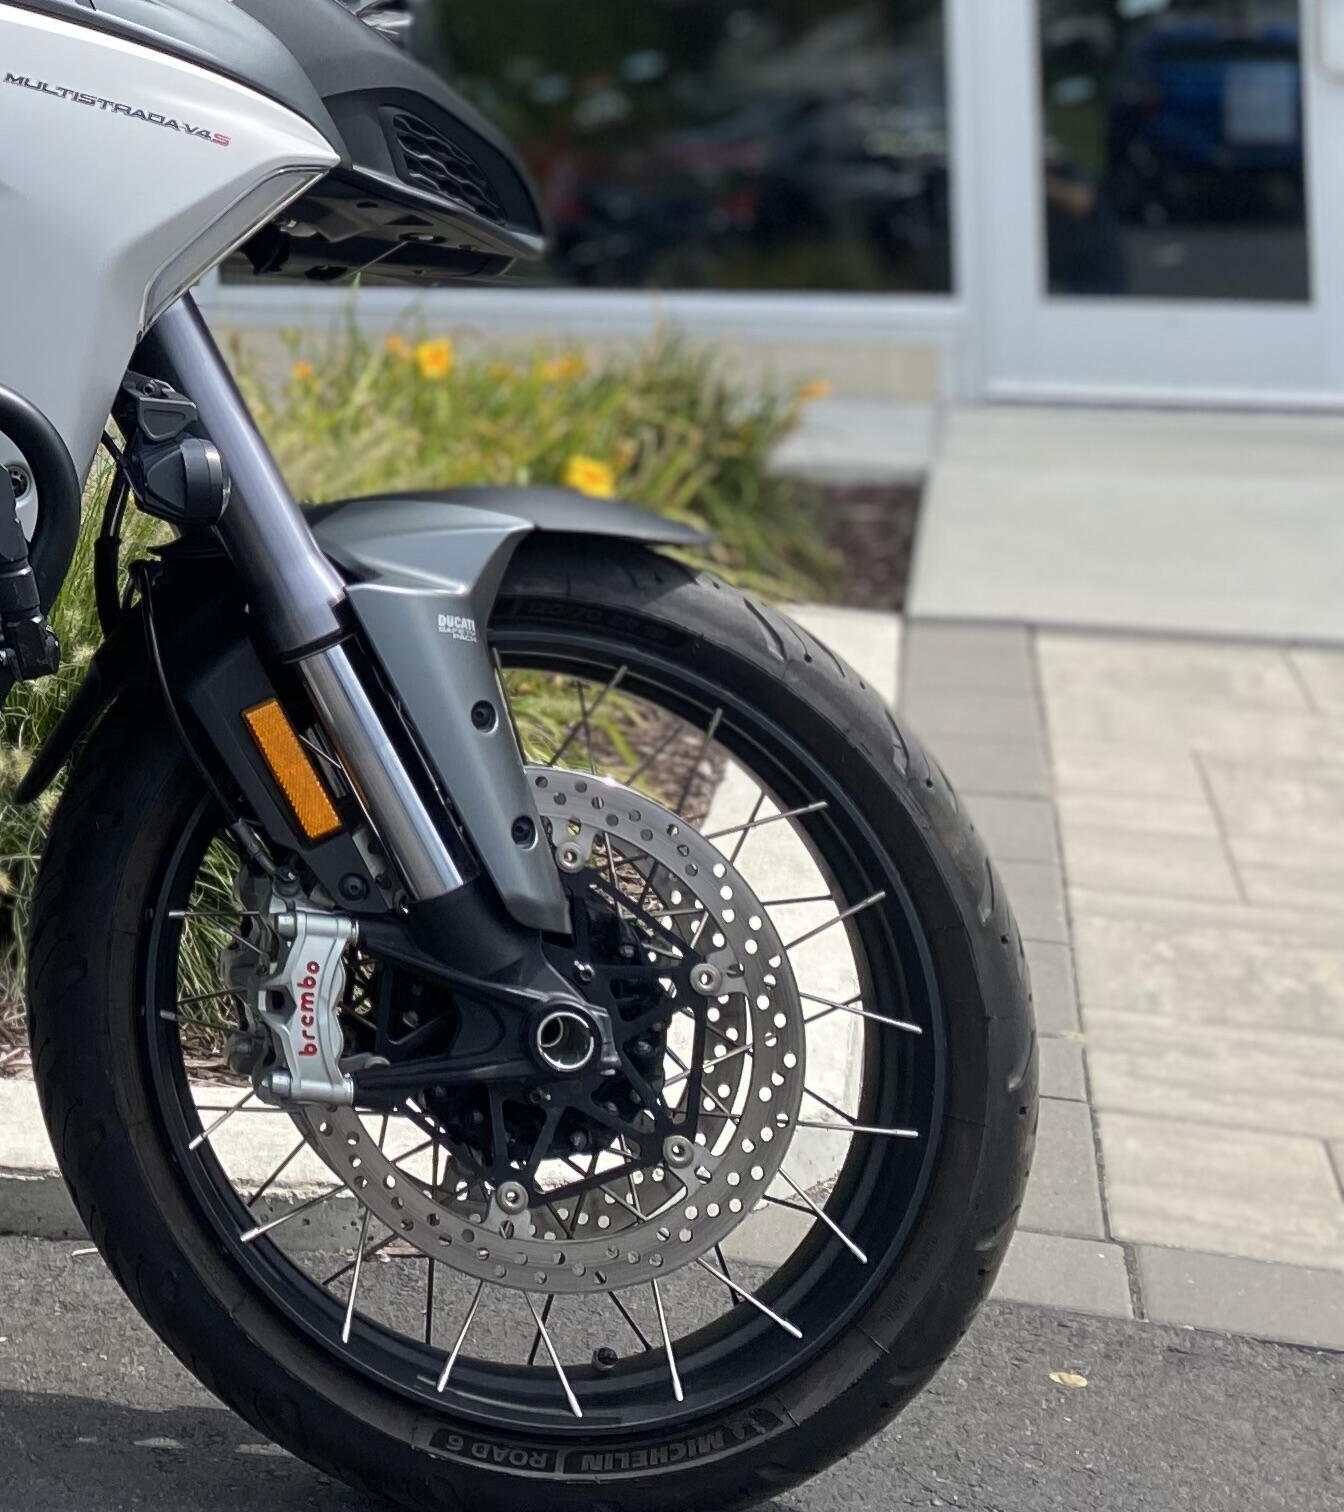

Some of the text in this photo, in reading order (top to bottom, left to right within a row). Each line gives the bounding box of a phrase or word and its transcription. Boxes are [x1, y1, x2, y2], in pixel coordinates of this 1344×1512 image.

[4, 72, 180, 130] MULTISTRADA
[438, 614, 476, 634] DUCATI
[297, 960, 320, 1057] brembo
[445, 1434, 726, 1472] MICHELIN ROAD 6
